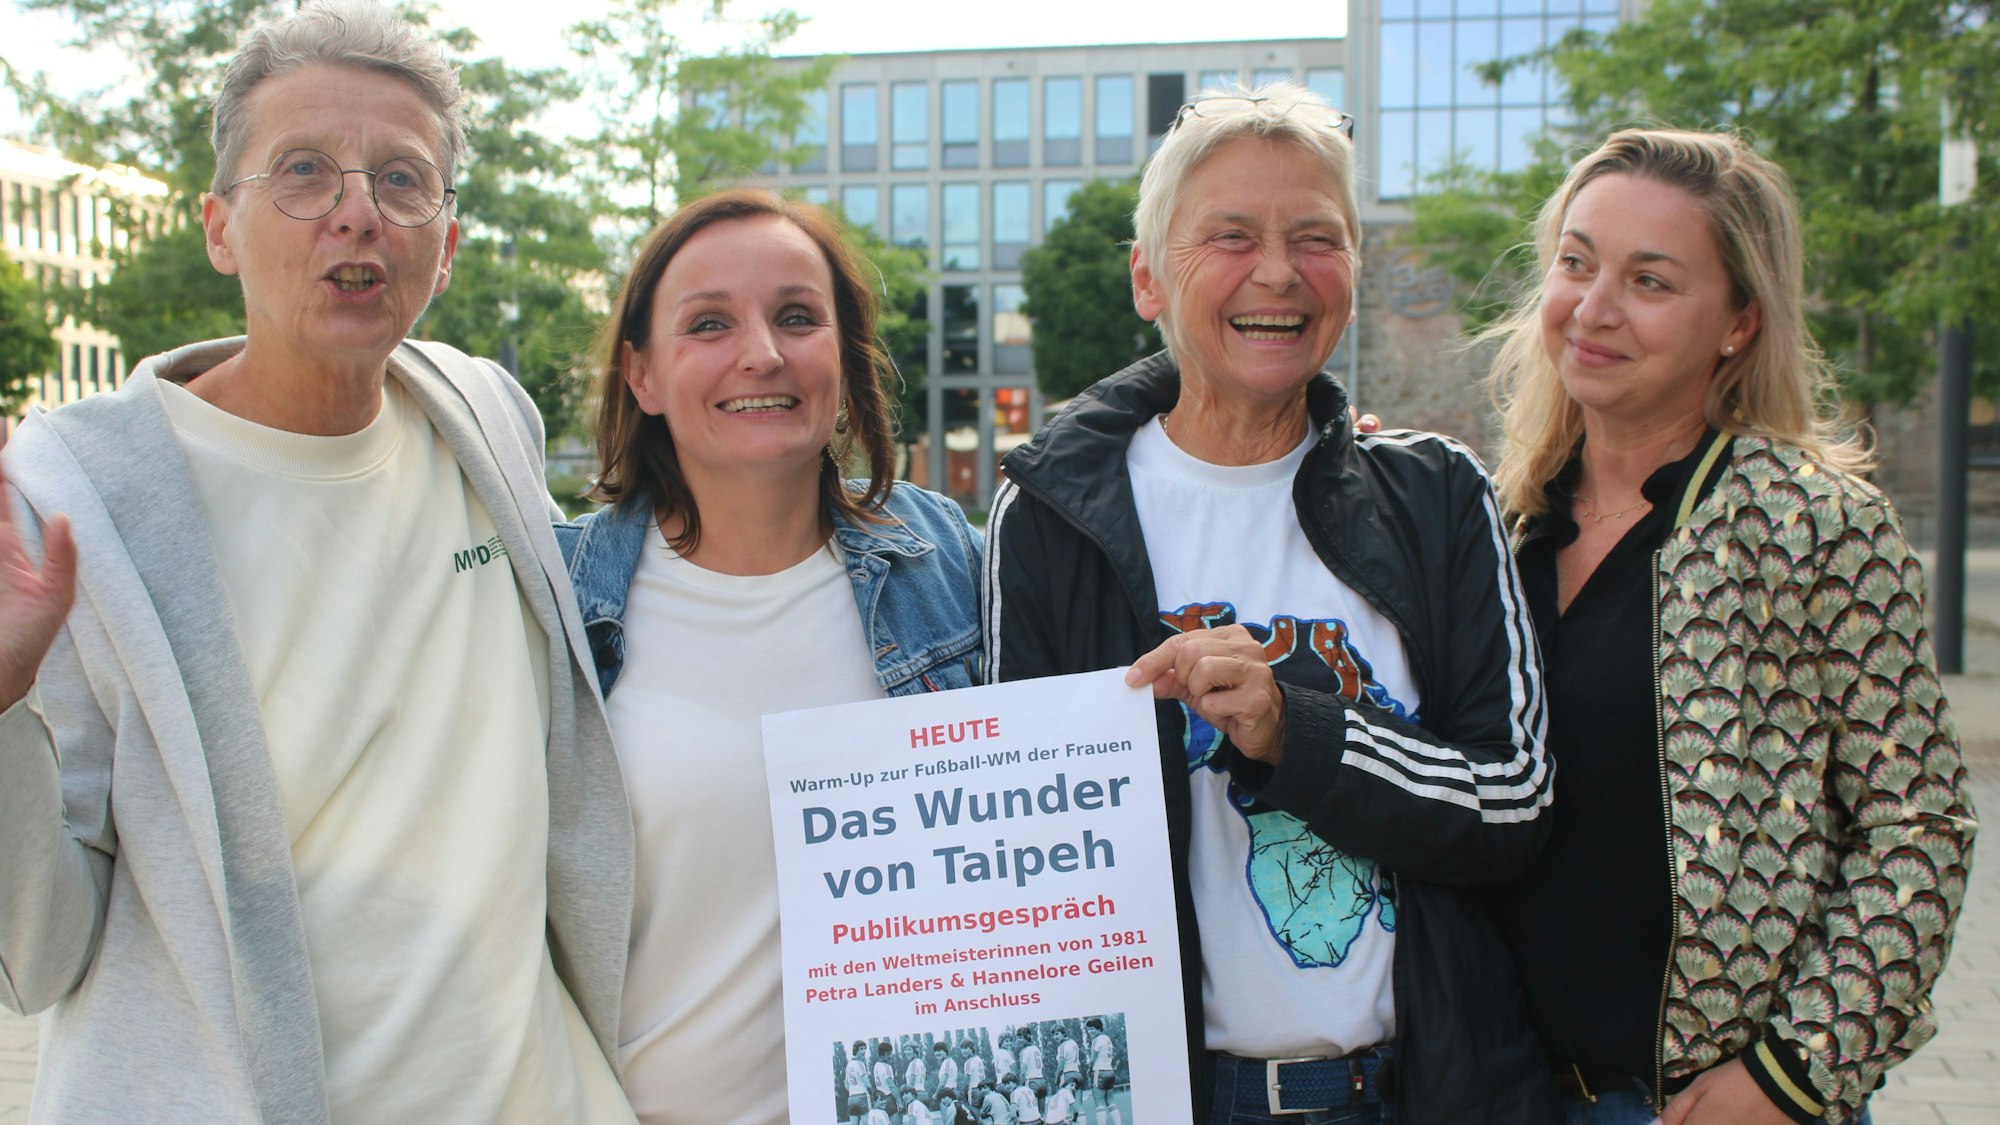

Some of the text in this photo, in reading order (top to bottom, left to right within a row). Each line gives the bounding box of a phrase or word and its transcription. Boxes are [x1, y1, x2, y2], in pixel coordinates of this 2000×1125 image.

[910, 717, 1001, 748] HEUTE
[790, 739, 1132, 794] Warm-Up zur Fußball-WM der Frauen
[802, 773, 1131, 845] Das Wunder
[823, 830, 1116, 899] von Taipeh
[832, 894, 1116, 944] Publikumsgespräch
[808, 929, 1148, 979] mit den Weltmeisterinnen von 1981
[805, 955, 1154, 1004] Petra Landers & Hannelore Geilen
[914, 992, 1041, 1016] im Anschluss
